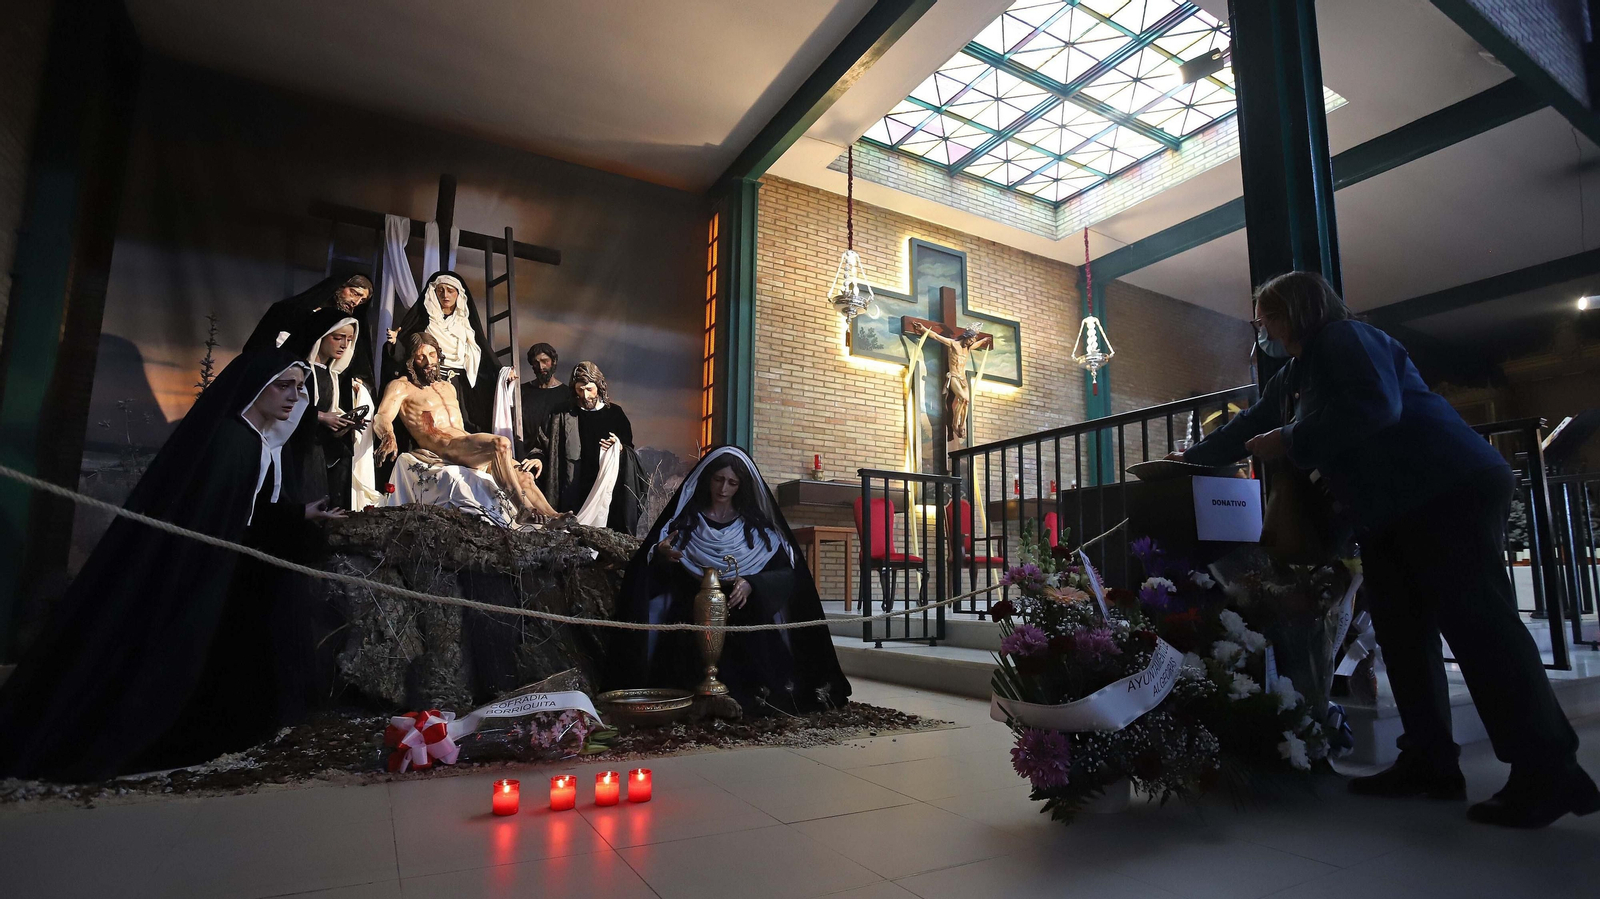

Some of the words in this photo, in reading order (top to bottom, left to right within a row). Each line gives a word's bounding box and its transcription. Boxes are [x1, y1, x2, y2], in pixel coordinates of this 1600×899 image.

[1211, 499, 1247, 507] DONATIVO
[485, 701, 557, 715] BORRIQUITA
[489, 694, 548, 709] COFRADIA
